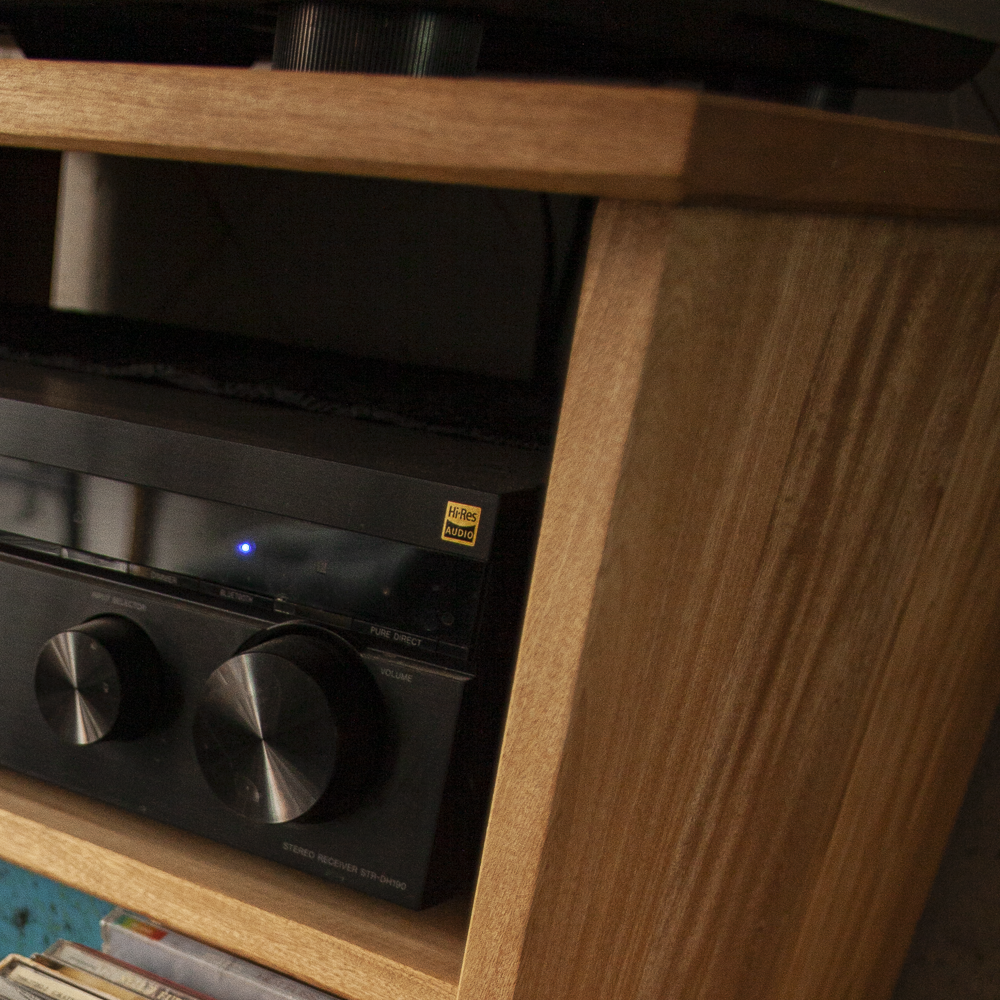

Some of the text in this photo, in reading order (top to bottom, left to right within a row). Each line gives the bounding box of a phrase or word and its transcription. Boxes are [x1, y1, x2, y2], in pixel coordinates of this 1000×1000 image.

[445, 526, 474, 540] AUDIO
[370, 625, 422, 646] PURE DIRECT
[380, 668, 413, 683] VOLUME
[282, 842, 315, 860] STEREO
[317, 855, 358, 873] RECEIVER
